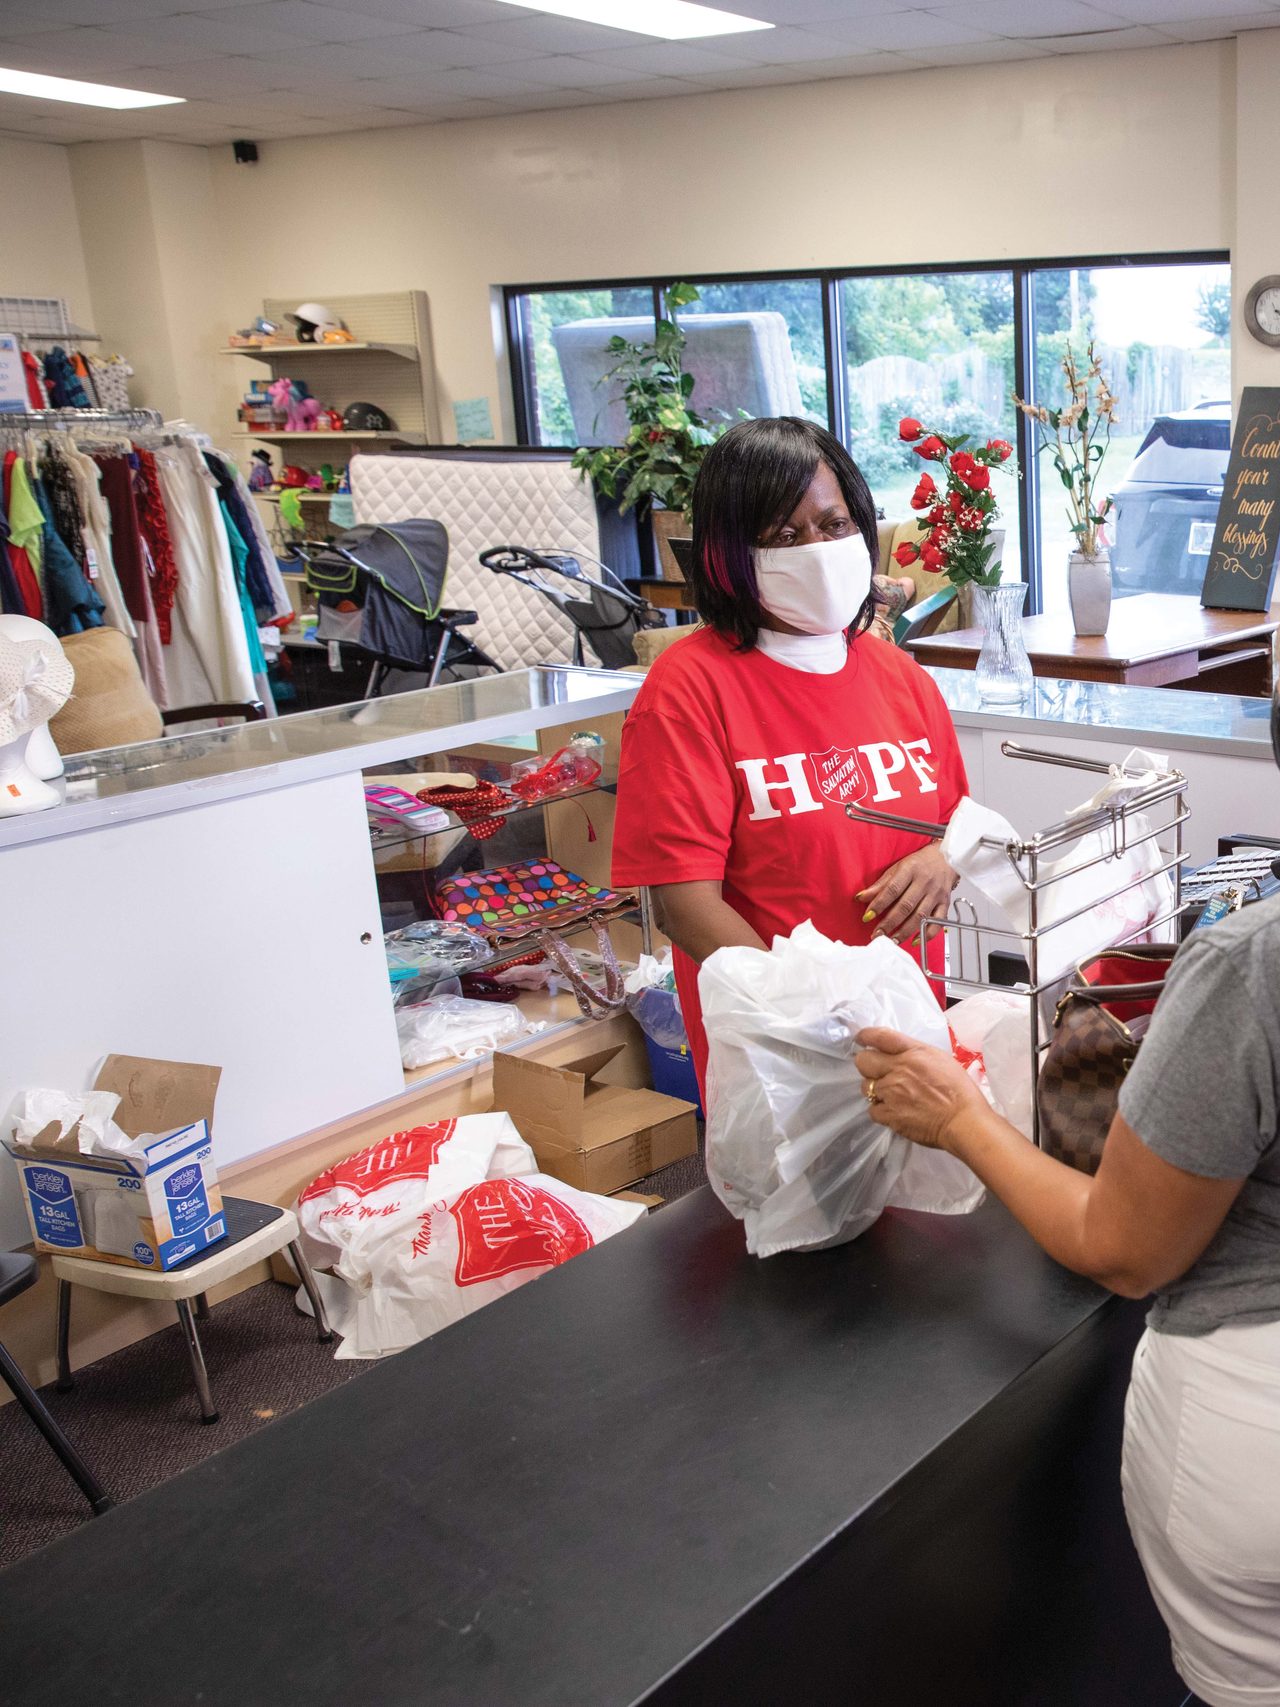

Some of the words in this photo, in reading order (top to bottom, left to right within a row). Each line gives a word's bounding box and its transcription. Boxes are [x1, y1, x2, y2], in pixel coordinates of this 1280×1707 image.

[1233, 468, 1270, 500] your
[1237, 498, 1275, 531] many
[1223, 523, 1269, 560] blessings
[821, 753, 841, 774] THE
[839, 770, 860, 800] ARMY
[196, 1147, 212, 1160] 200
[32, 1169, 64, 1186] berkley
[117, 1177, 141, 1189] 200
[170, 1168, 197, 1186] berkley
[34, 1180, 64, 1193] jensen
[40, 1205, 54, 1217] 13
[54, 1210, 70, 1220] GAL
[176, 1201, 188, 1213] 13
[187, 1196, 201, 1207] GAL
[38, 1216, 52, 1224] TALL
[474, 1193, 520, 1250] THE
